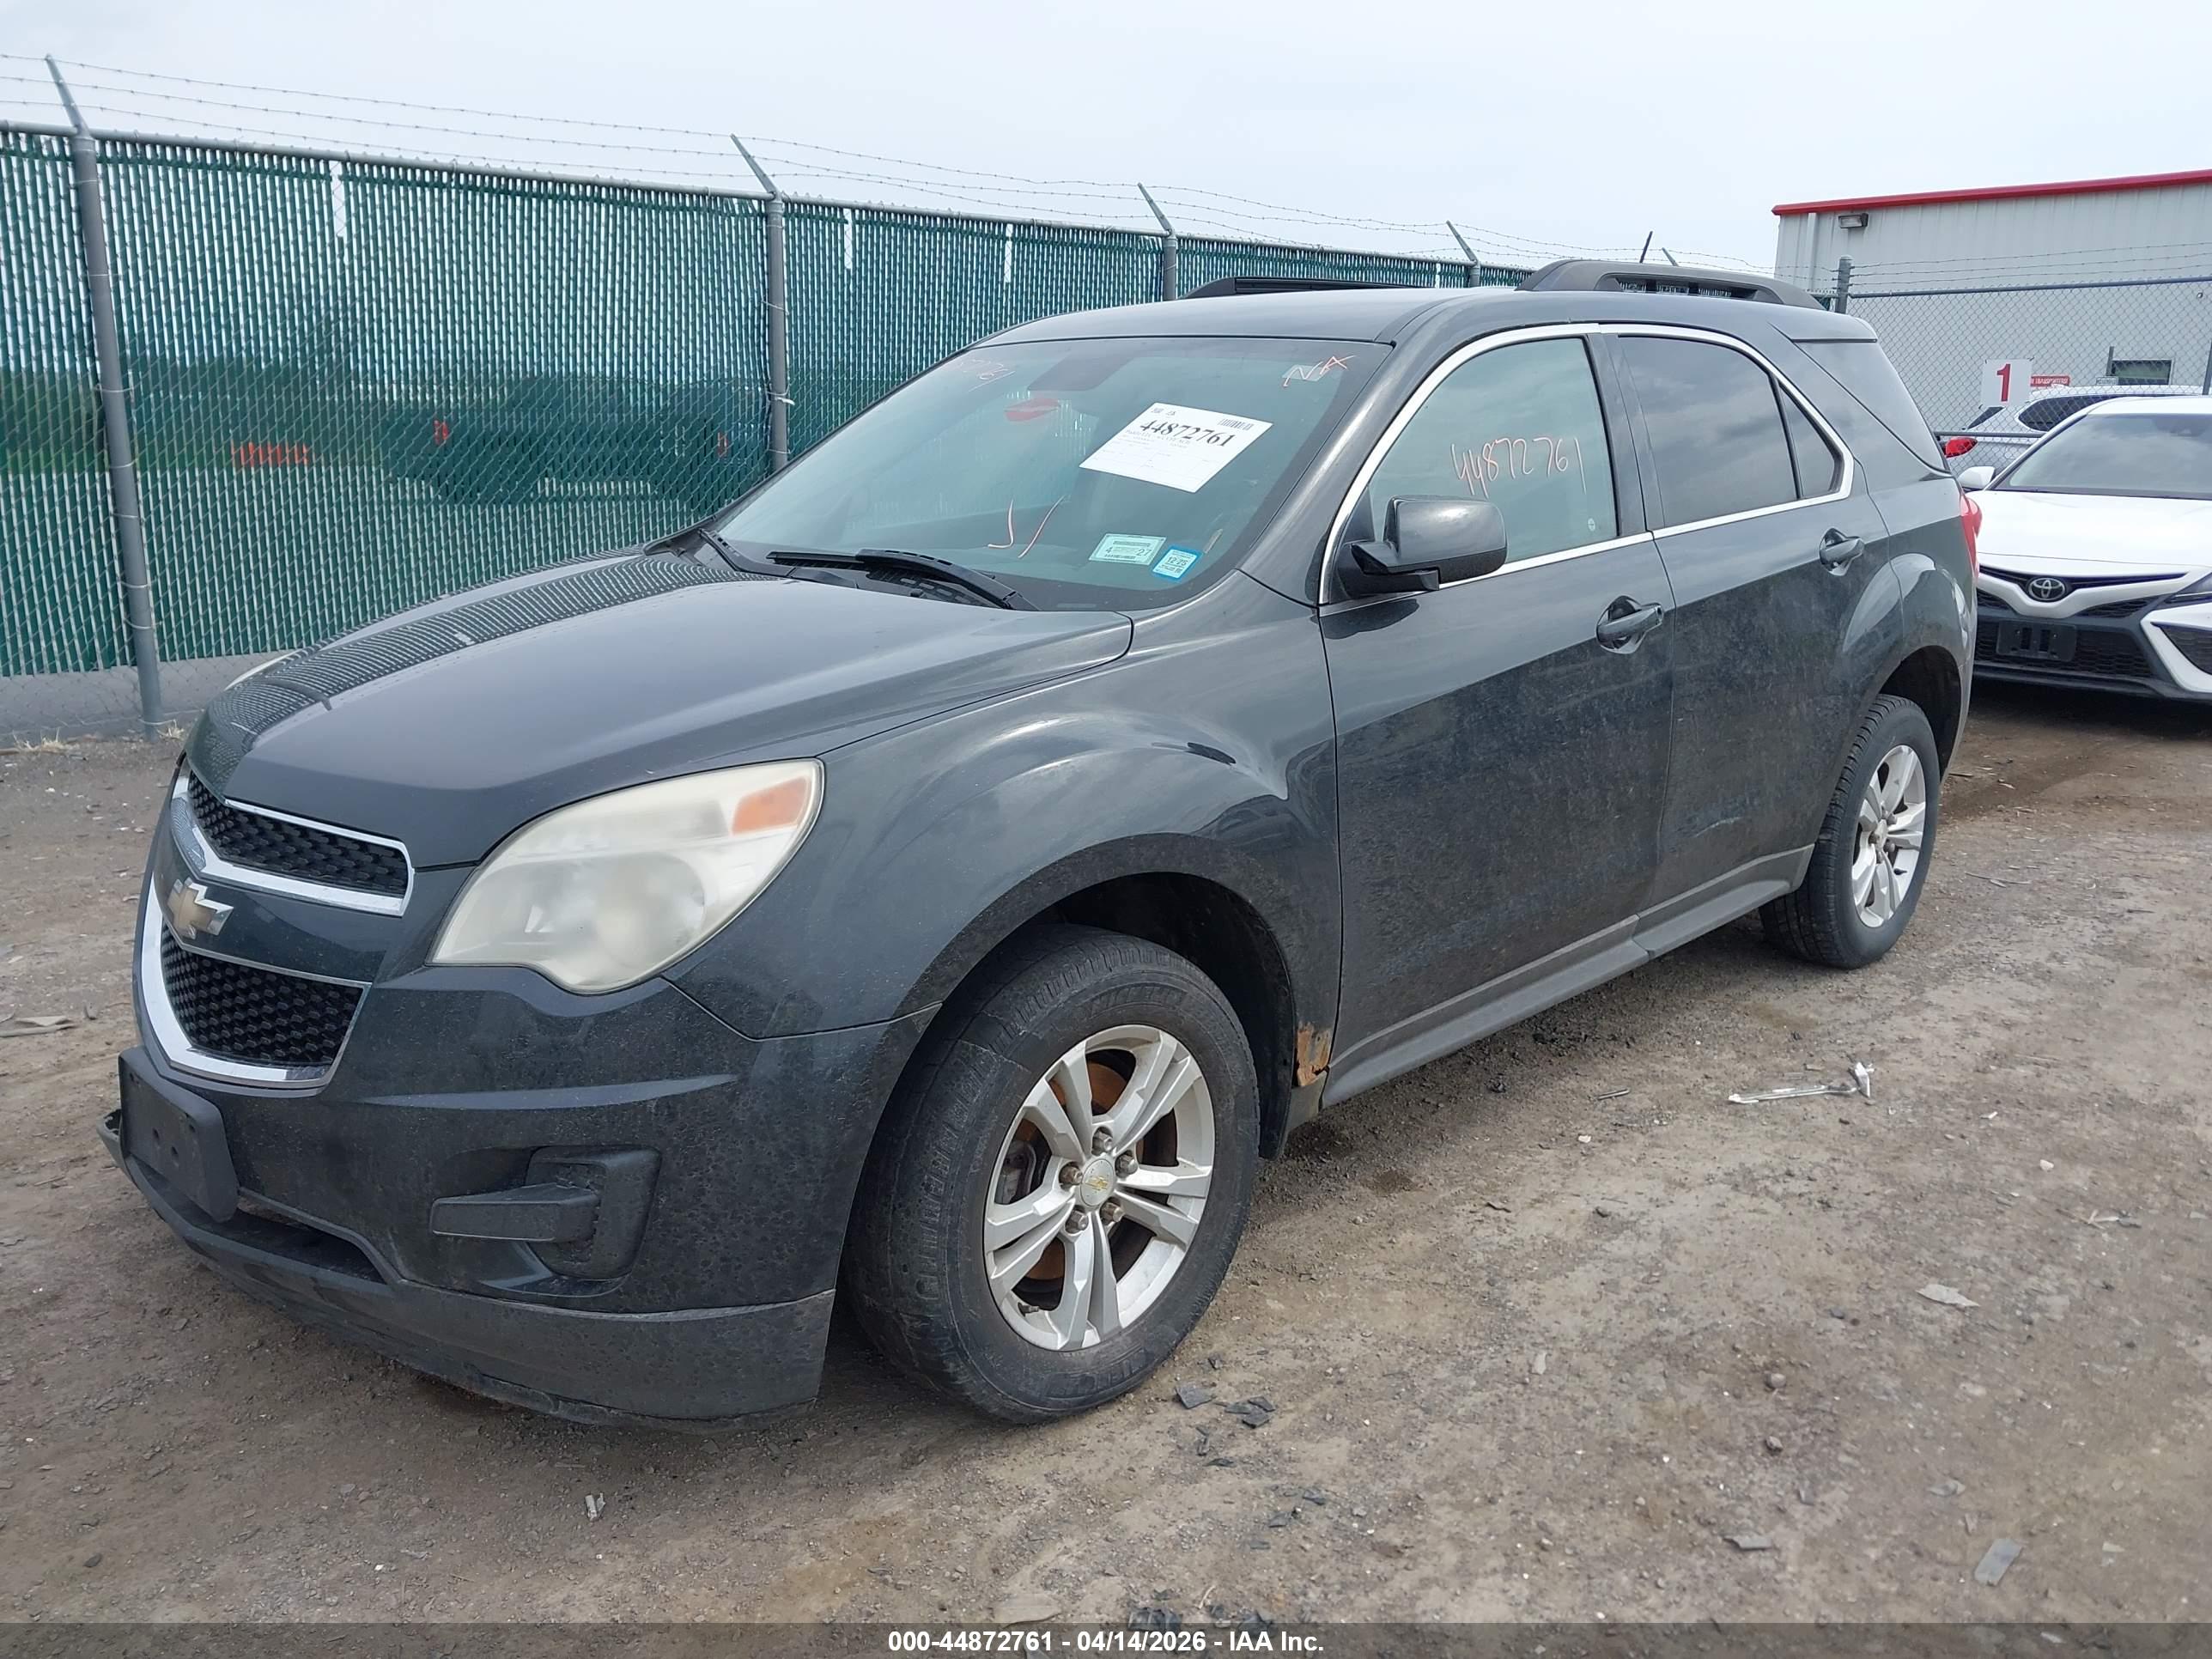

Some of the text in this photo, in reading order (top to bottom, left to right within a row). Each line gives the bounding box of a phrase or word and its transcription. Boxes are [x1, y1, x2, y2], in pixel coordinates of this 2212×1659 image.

[1996, 363, 2011, 402] 1
[1139, 419, 1236, 447] 44872761
[1450, 436, 1586, 498] 44872761
